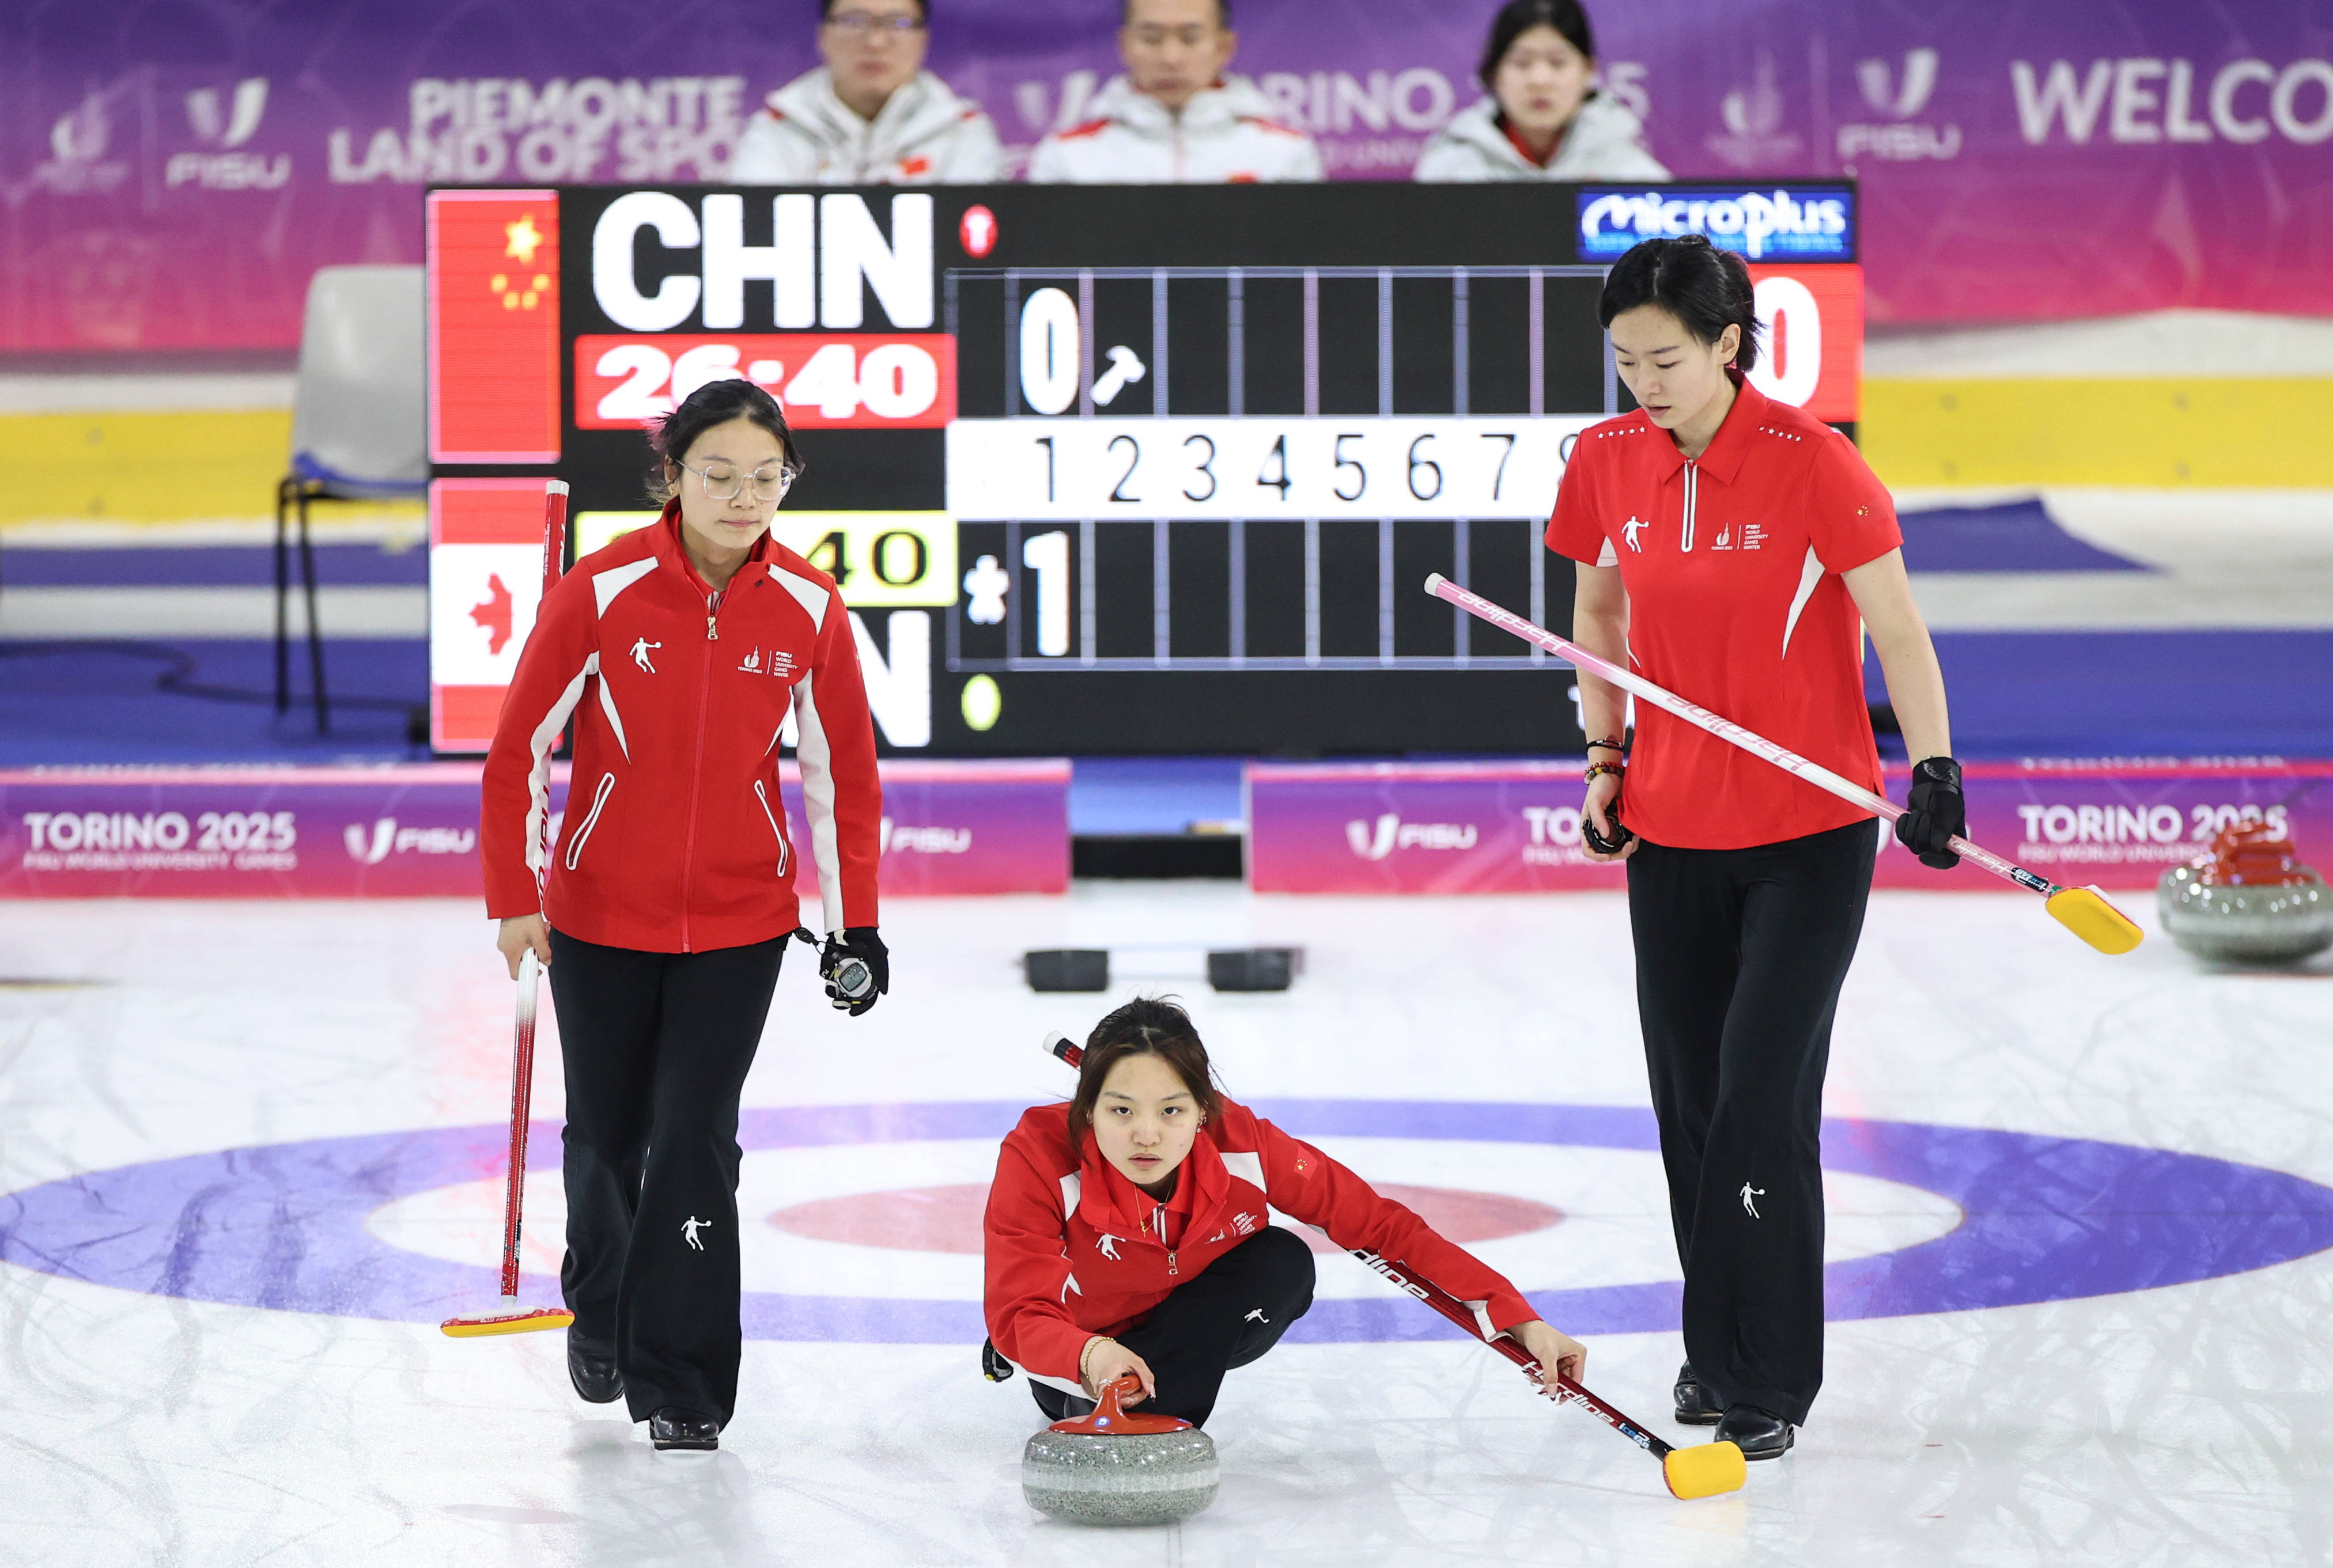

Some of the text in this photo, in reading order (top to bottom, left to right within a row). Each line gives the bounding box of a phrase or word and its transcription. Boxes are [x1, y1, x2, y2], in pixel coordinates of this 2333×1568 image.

[411, 77, 744, 131] PIEMONTE
[1263, 67, 1455, 134] RINO
[329, 127, 736, 183] LAND OF SPO
[1582, 189, 1846, 259] Microplus
[593, 191, 935, 332] CHN
[1020, 287, 1079, 415] 0
[1746, 276, 1821, 408] 0
[1035, 435, 1054, 502] 1
[1107, 435, 1141, 502] 2
[1182, 434, 1216, 502] 3
[1257, 434, 1291, 501] 4
[1333, 434, 1366, 501] 5
[1406, 434, 1442, 501] 6
[1480, 434, 1517, 501] 7
[1023, 531, 1070, 656] 1
[1457, 592, 1570, 652] Hardline
[1665, 694, 1812, 771] Hardline
[22, 811, 297, 851] TORINO 2025
[2018, 804, 2184, 843] TORINO
[1351, 1248, 1430, 1301] dline
